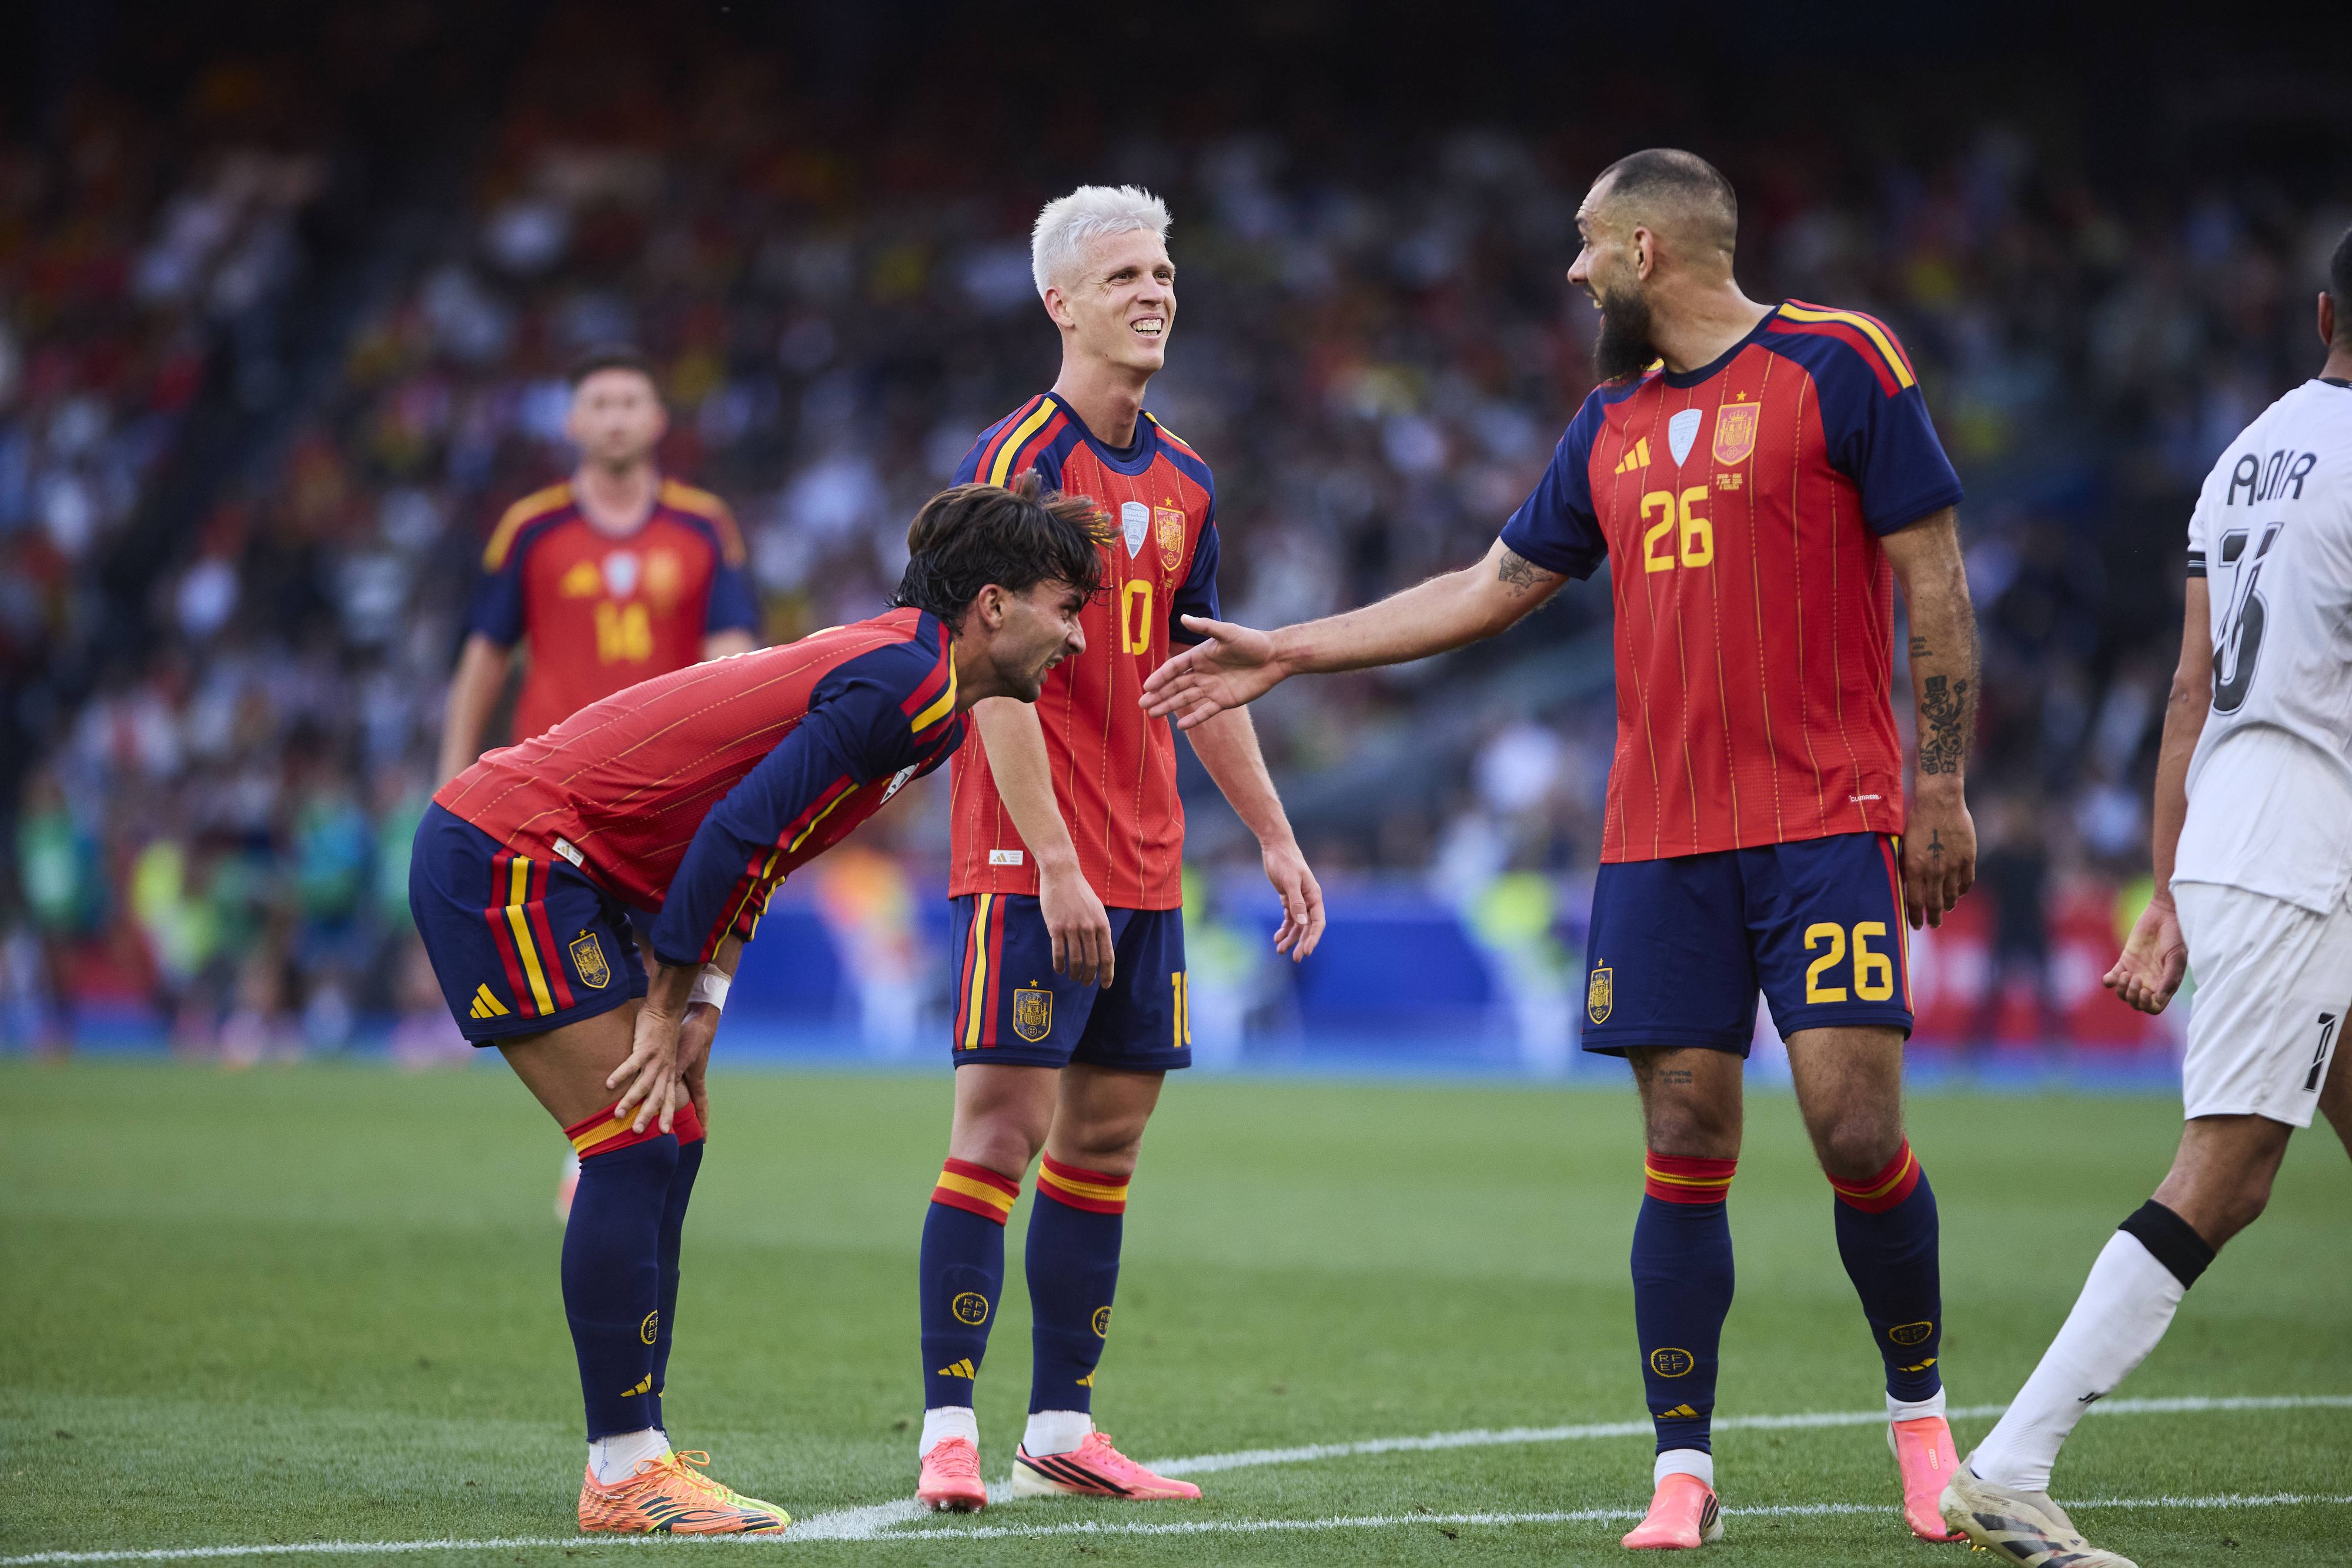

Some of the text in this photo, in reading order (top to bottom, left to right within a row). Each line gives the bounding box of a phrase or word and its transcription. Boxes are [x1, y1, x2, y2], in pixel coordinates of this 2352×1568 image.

[1640, 485, 1713, 573] 26
[1120, 576, 1153, 655] 10
[1804, 921, 1893, 1004] 26
[962, 1307, 981, 1318] EF
[964, 1298, 983, 1308] RF
[1661, 1362, 1683, 1371] EF
